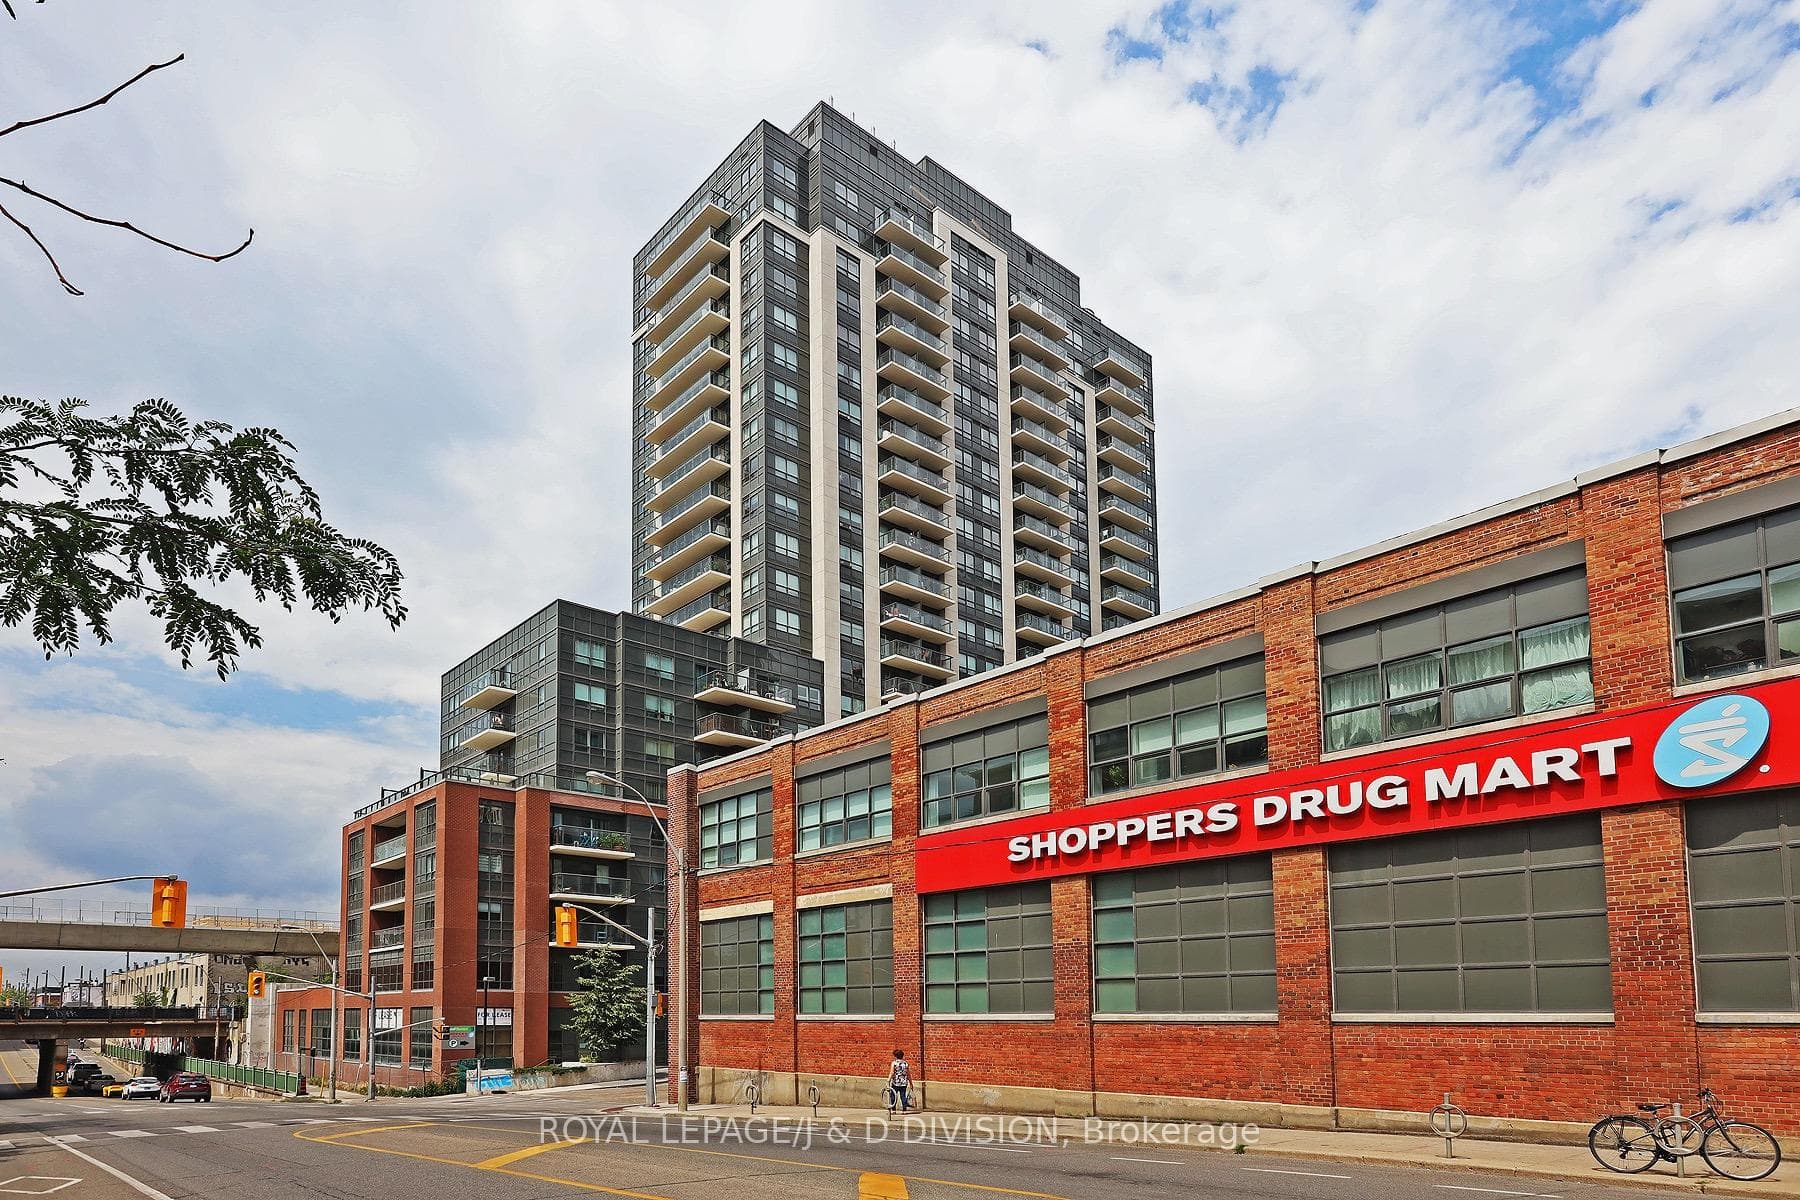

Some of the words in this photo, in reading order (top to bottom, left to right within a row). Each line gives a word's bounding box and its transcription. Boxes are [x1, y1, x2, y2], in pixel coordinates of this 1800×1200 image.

[1007, 802, 1239, 862] SHOPPERS
[1254, 775, 1409, 826] DRUG
[1425, 737, 1632, 802] MART
